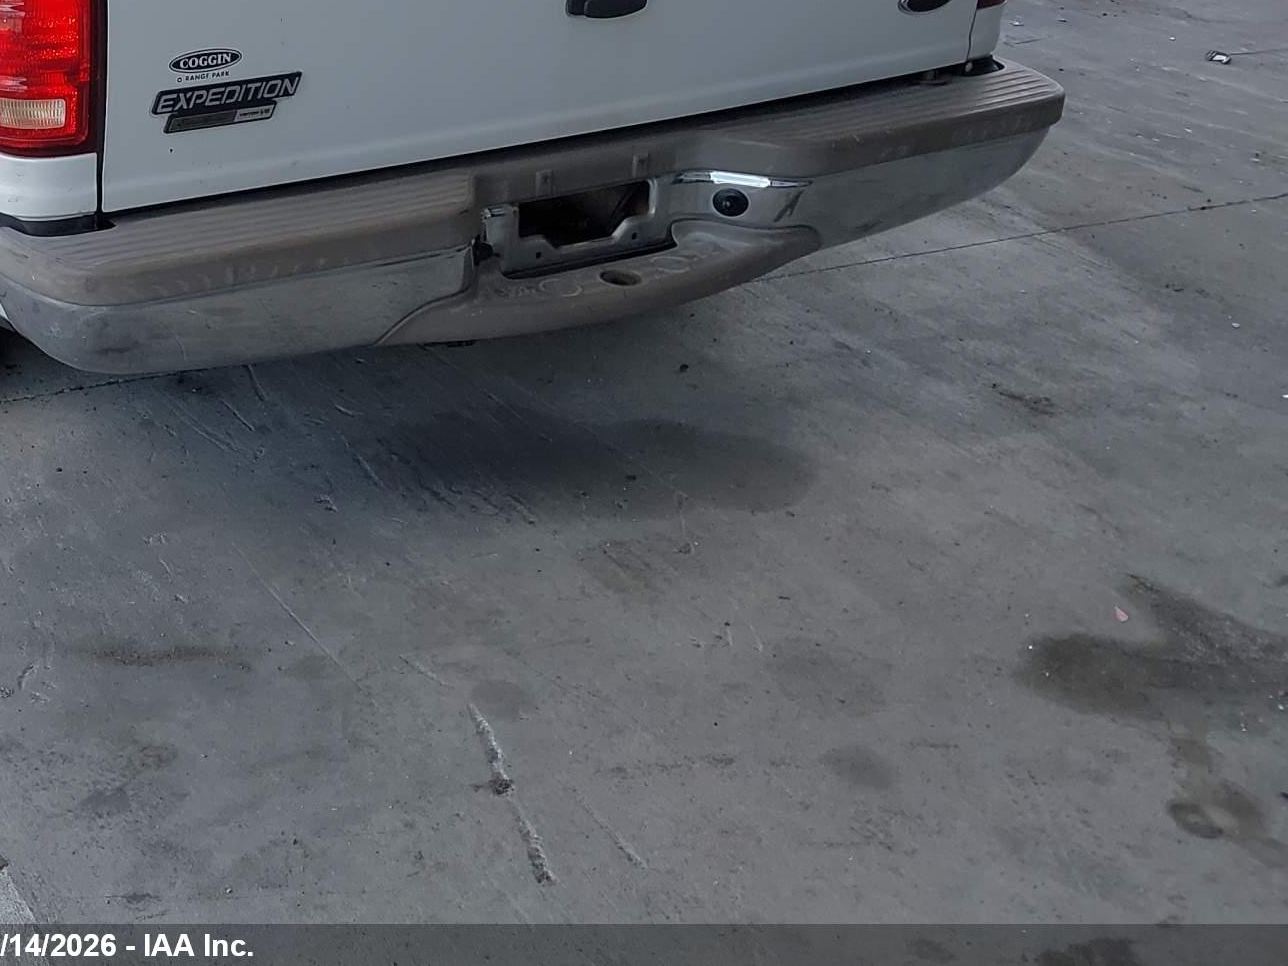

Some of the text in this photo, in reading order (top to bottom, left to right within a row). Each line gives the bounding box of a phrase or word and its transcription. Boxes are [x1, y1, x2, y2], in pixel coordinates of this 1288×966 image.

[179, 53, 232, 69] COGGIN
[211, 70, 230, 79] PARK
[156, 76, 300, 113] EXPEDITION
